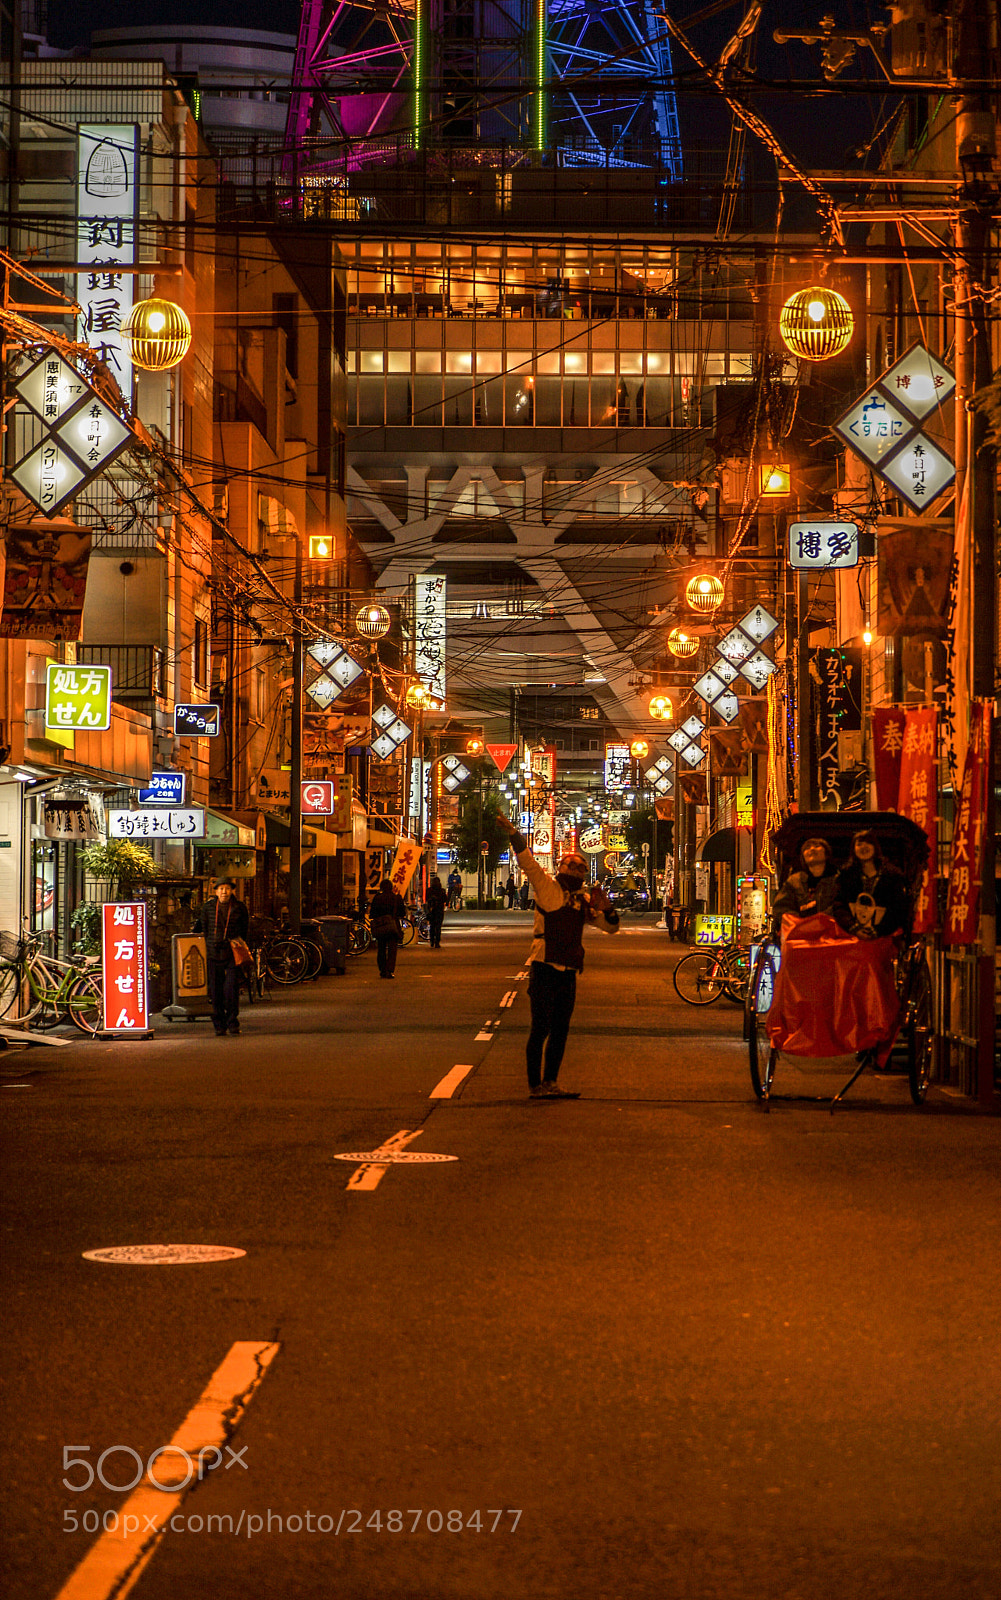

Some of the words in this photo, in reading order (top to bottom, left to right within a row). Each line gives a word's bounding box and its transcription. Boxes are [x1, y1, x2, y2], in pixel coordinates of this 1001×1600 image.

[45, 361, 59, 417] 恵美須東
[895, 374, 945, 389] 博多
[41, 447, 56, 504] クリニック
[912, 444, 927, 496] 春日町会
[795, 530, 850, 559] 博多
[53, 669, 105, 695] 処方
[52, 702, 102, 725] せん
[904, 722, 934, 760] 奉納
[258, 789, 290, 799] とまり木
[702, 915, 731, 924] カラオケ
[113, 906, 135, 1028] 処方せん
